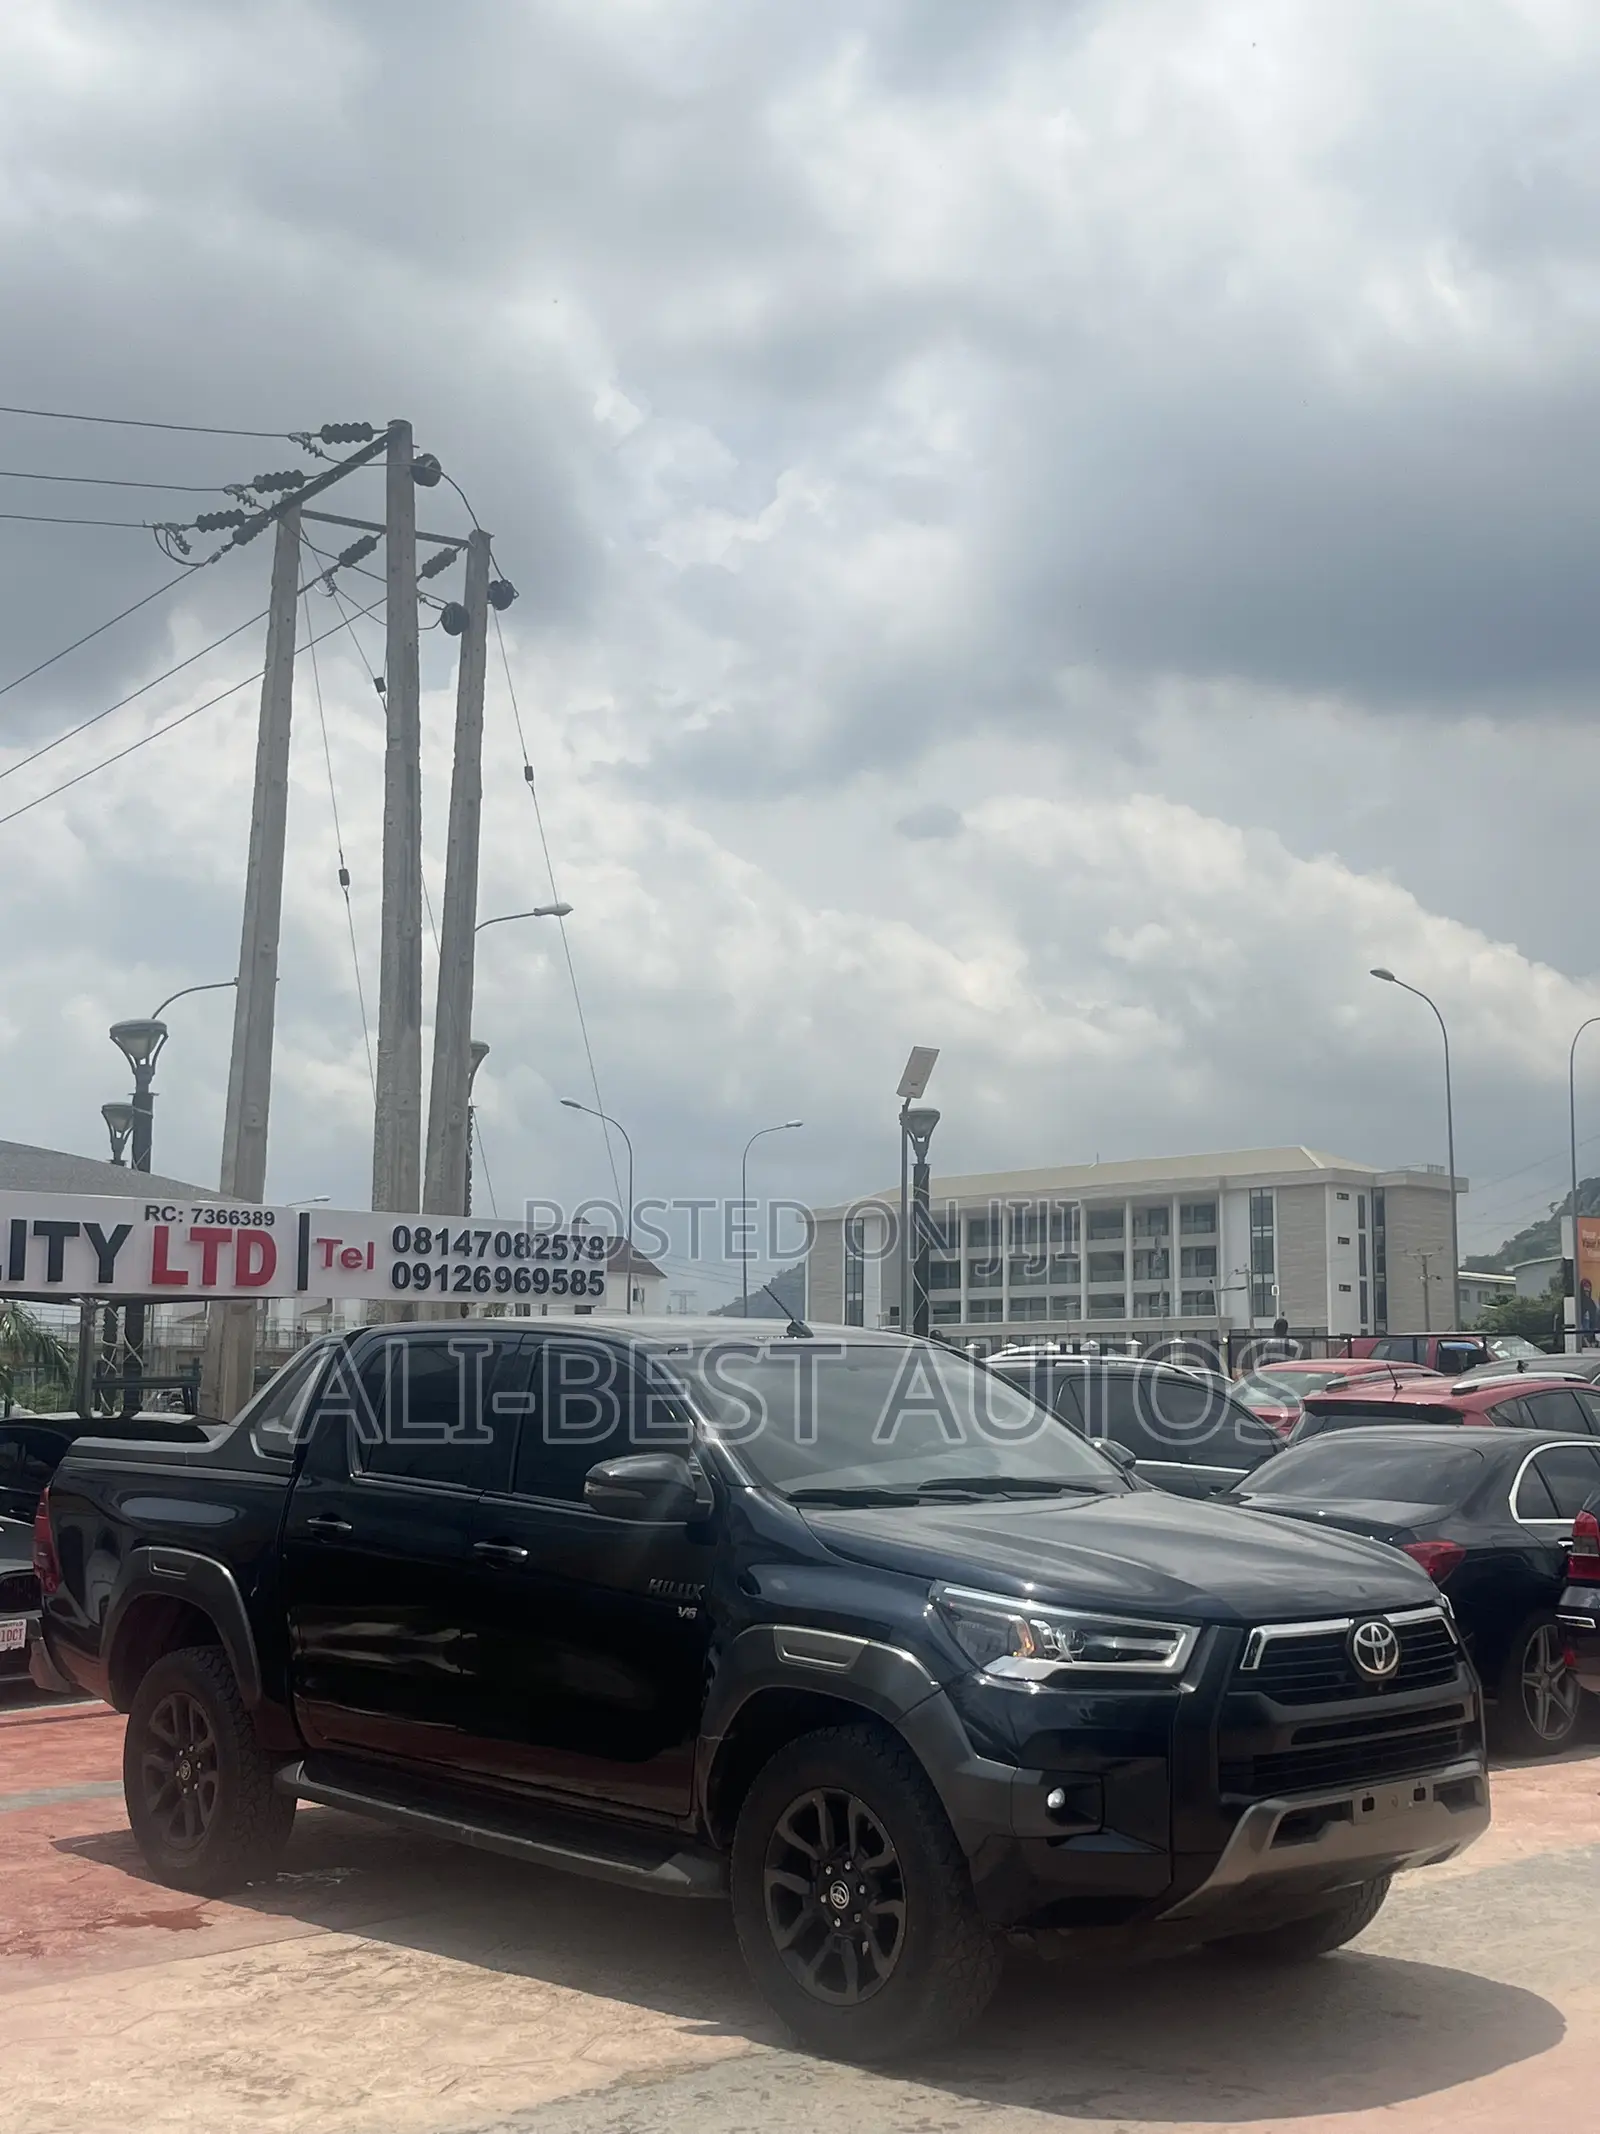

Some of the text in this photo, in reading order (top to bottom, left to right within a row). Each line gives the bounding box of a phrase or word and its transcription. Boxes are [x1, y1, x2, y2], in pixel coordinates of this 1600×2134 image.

[145, 1205, 275, 1226] RC: 7366389
[0, 1218, 277, 1287] ITY LTD
[316, 1237, 375, 1270] Tel
[392, 1224, 605, 1262] 08147082578
[391, 1260, 605, 1296] 09126969585
